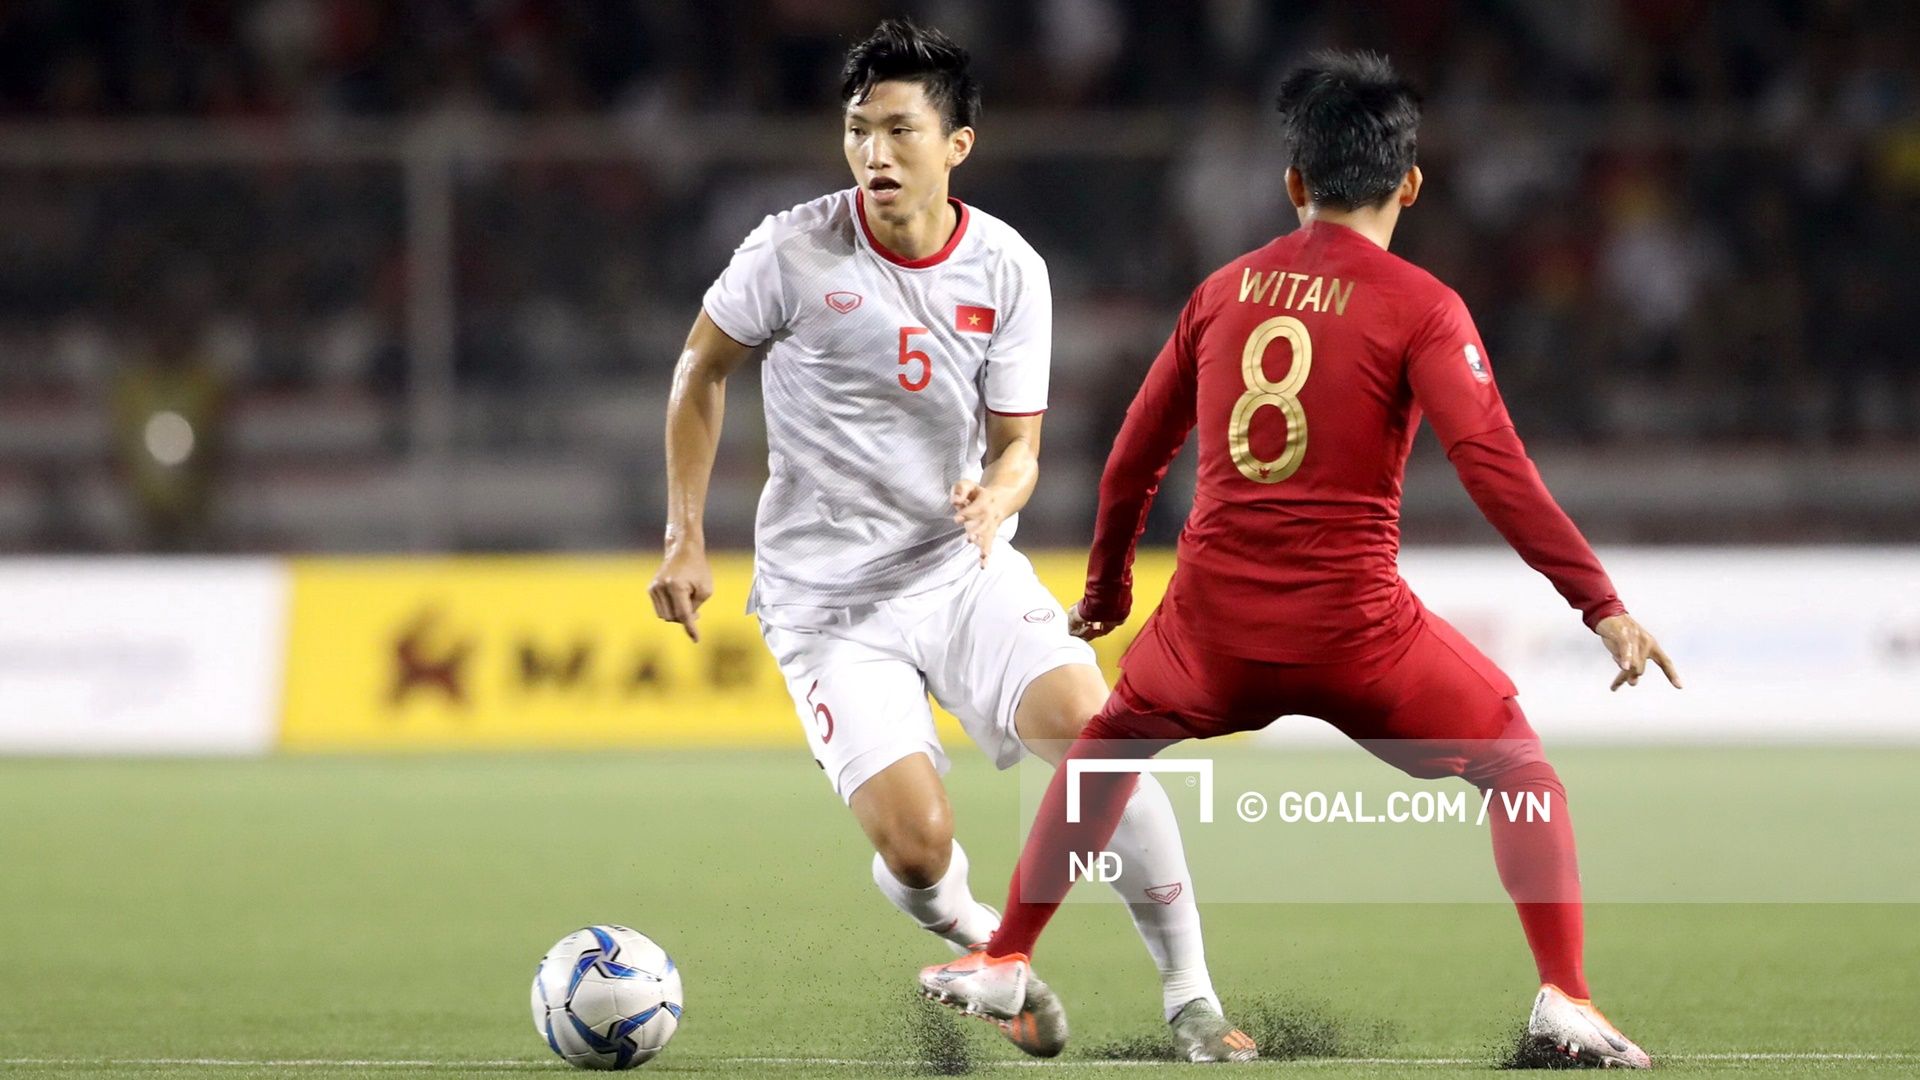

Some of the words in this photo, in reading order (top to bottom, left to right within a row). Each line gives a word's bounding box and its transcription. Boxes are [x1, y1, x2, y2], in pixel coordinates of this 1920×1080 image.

[1238, 267, 1355, 316] WITAN
[898, 326, 932, 392] 5
[1228, 316, 1312, 484] 8
[806, 679, 834, 744] 5
